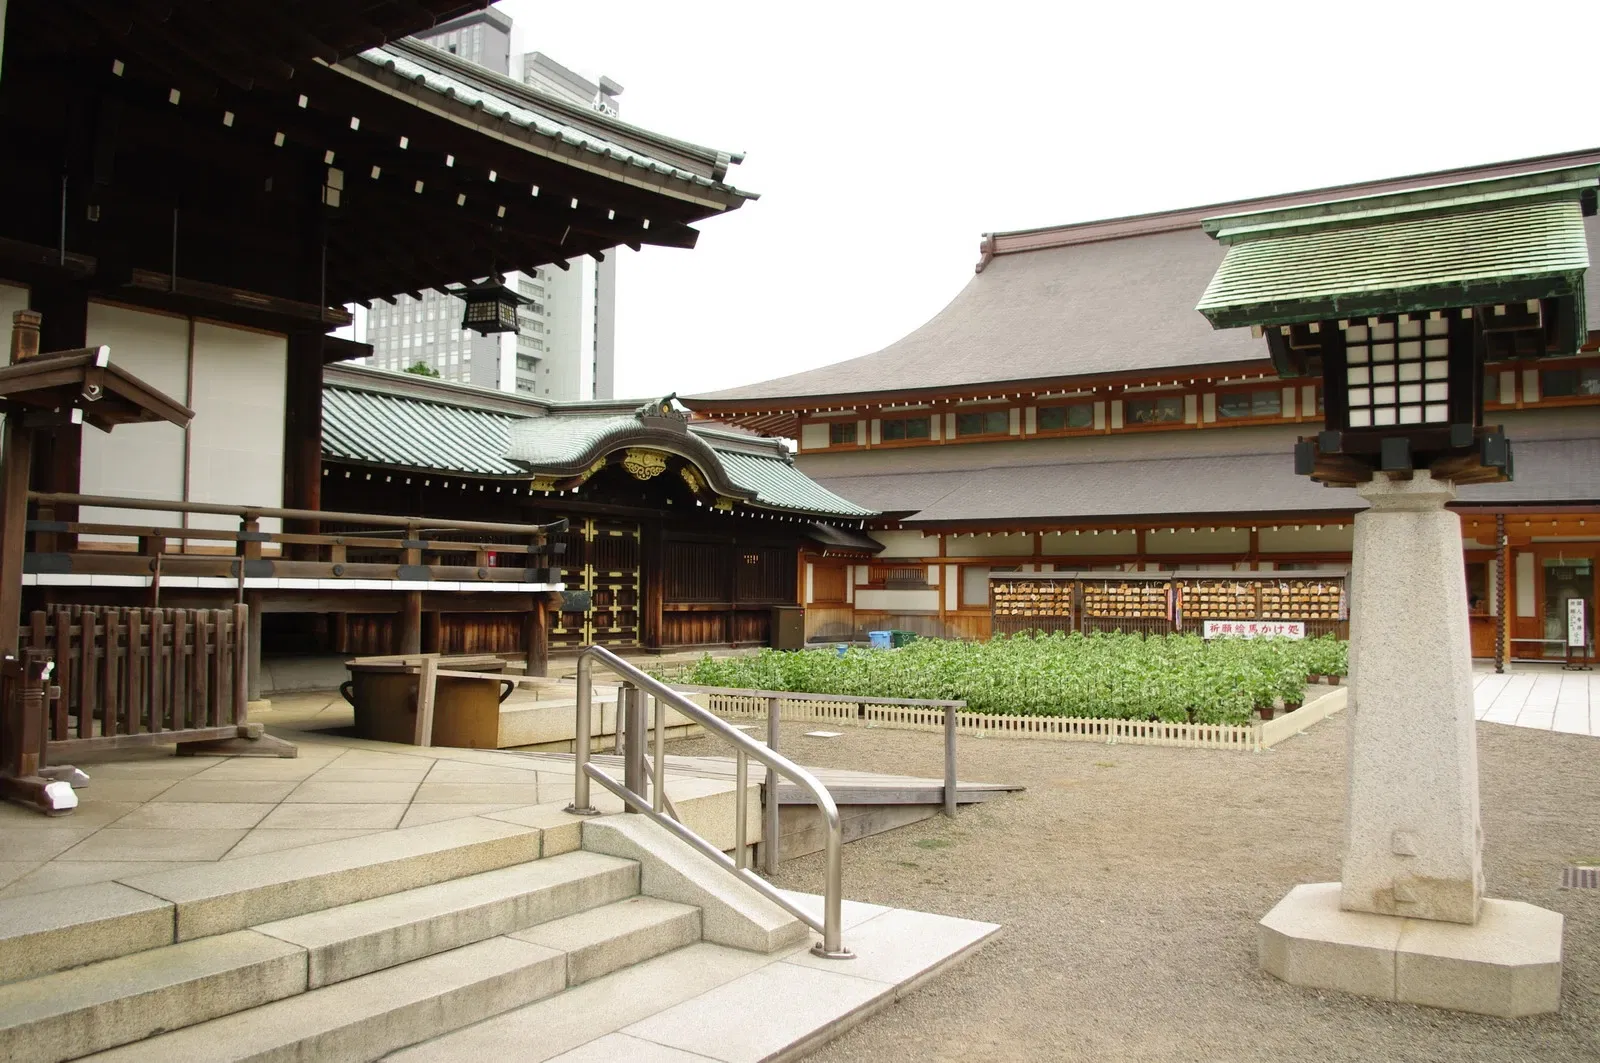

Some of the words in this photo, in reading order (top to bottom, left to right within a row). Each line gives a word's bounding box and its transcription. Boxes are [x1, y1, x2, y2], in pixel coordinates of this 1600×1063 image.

[1209, 623, 1299, 635] 祈願絵馬かけ処
